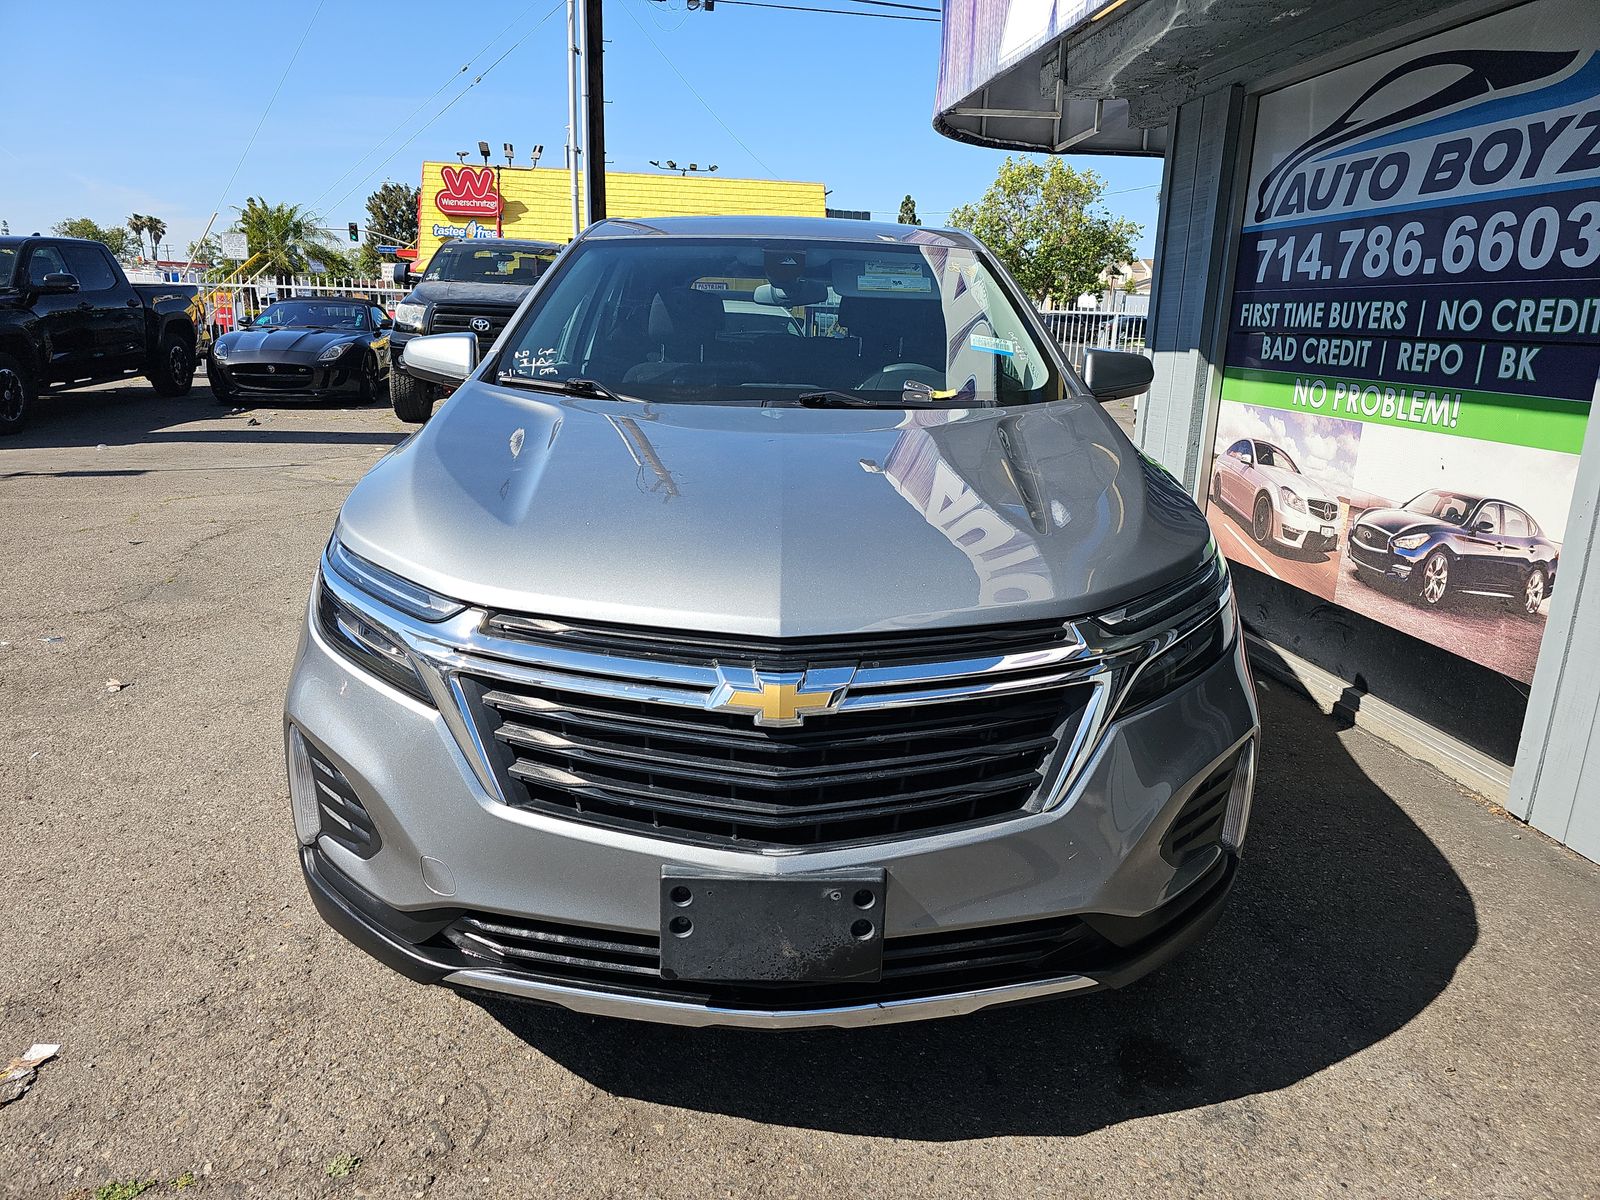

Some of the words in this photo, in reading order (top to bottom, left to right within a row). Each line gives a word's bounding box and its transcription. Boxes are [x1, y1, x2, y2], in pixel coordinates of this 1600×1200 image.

[1274, 151, 1411, 217] AUTO
[1418, 110, 1600, 196] BOYZ
[441, 198, 497, 209] Wienerschnitzel
[434, 225, 466, 237] tastee
[1256, 201, 1600, 284] 714.786.6603
[1240, 302, 1280, 328] FIRST
[1283, 302, 1325, 328] TIME
[1328, 300, 1409, 330] BUYERS
[1436, 300, 1483, 332] NO
[1491, 299, 1600, 334] CREDIT
[1261, 335, 1298, 362] BAD
[1302, 337, 1373, 368] CREDIT
[1396, 342, 1464, 375] REPO
[1497, 346, 1543, 382] BK
[1293, 378, 1327, 409] NO
[1332, 382, 1461, 429] PROBLEM!
